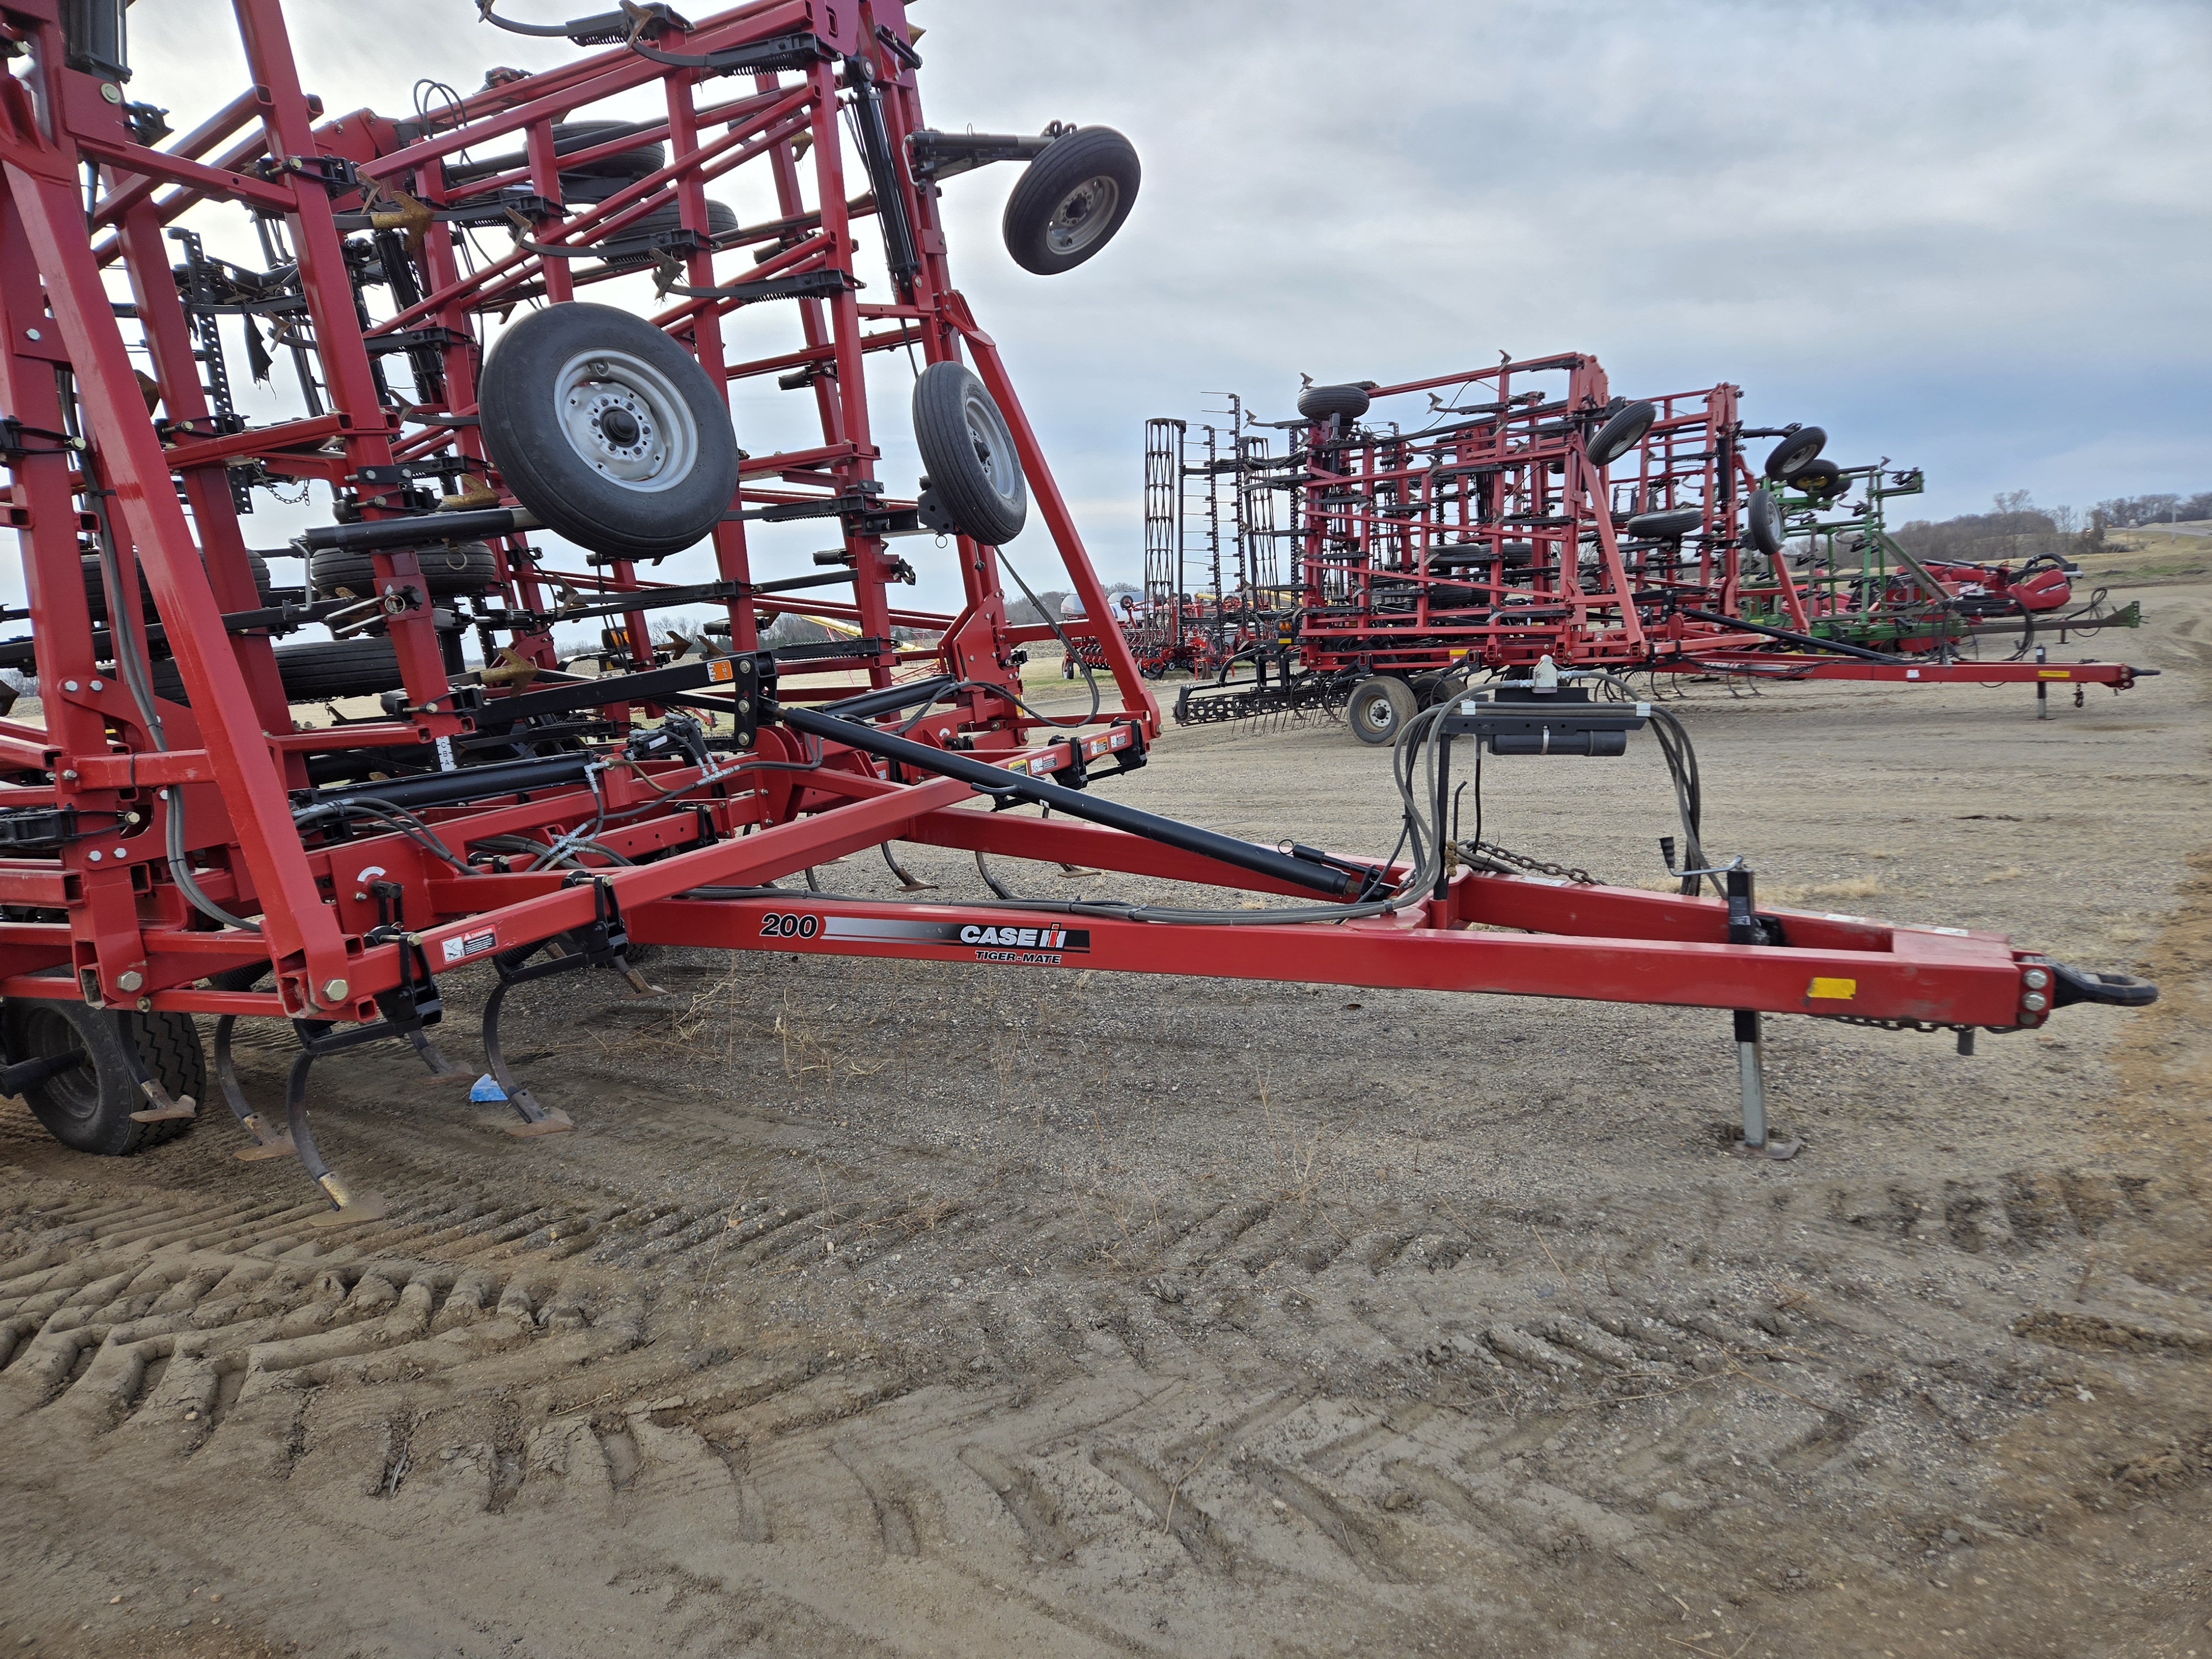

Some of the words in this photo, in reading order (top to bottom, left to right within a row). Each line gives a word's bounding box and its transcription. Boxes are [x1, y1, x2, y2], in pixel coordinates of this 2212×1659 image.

[759, 912, 818, 939] 200
[960, 925, 1038, 947] CASE
[975, 950, 1062, 964] TIGER-MATE
